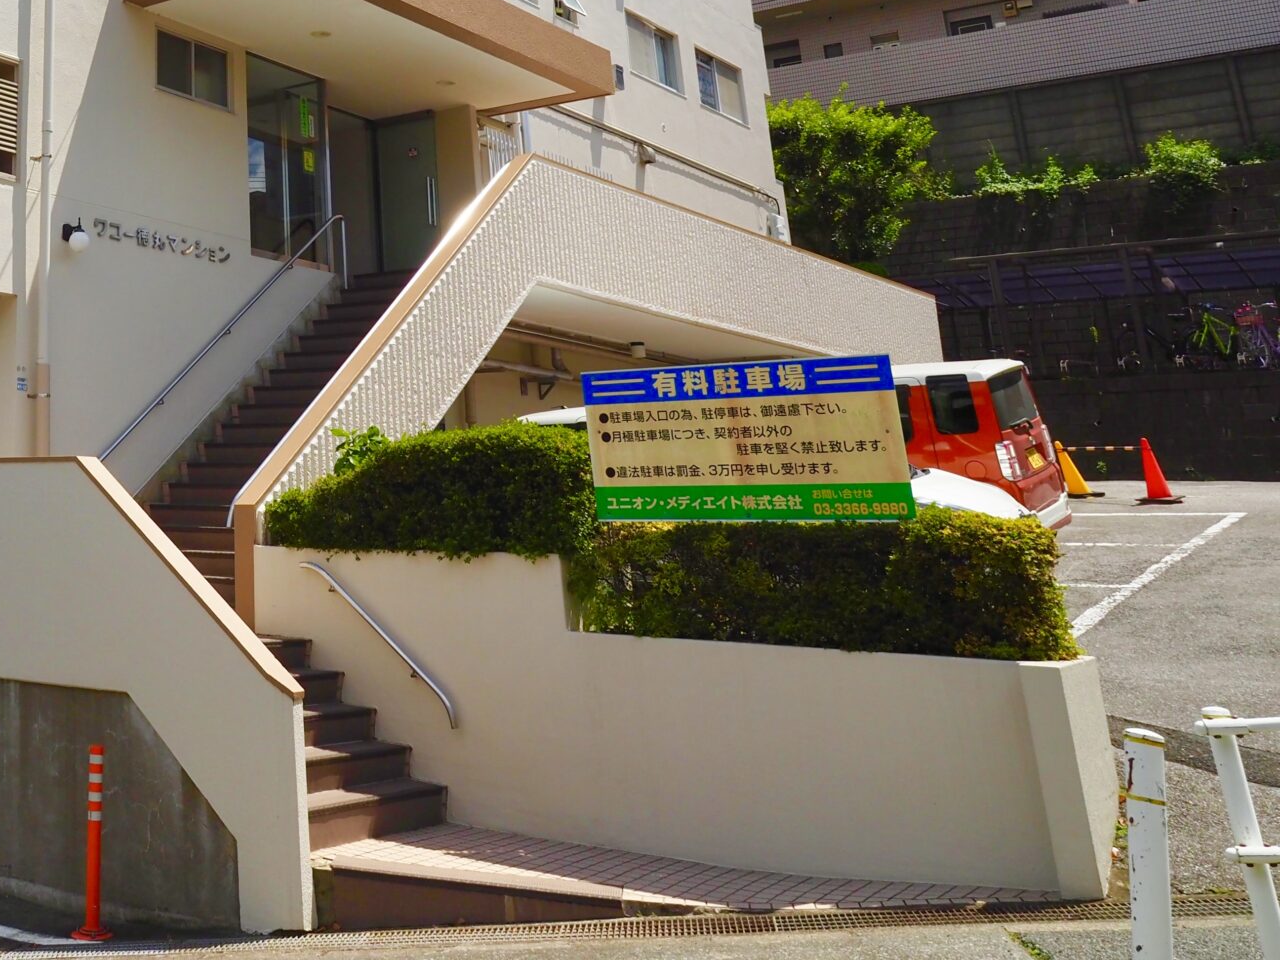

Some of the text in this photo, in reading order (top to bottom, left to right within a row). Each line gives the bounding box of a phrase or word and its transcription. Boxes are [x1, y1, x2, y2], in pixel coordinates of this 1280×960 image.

[652, 364, 806, 398] 有料駐車場
[612, 425, 793, 443] 月極駐車場につき、契約者以外の
[736, 440, 887, 457] 駐車を堅く禁止致します。
[812, 489, 873, 499] お問い合せは
[607, 495, 804, 510] ユニオン・メディエイト株式会社
[813, 502, 909, 516] 03-3366-9980
